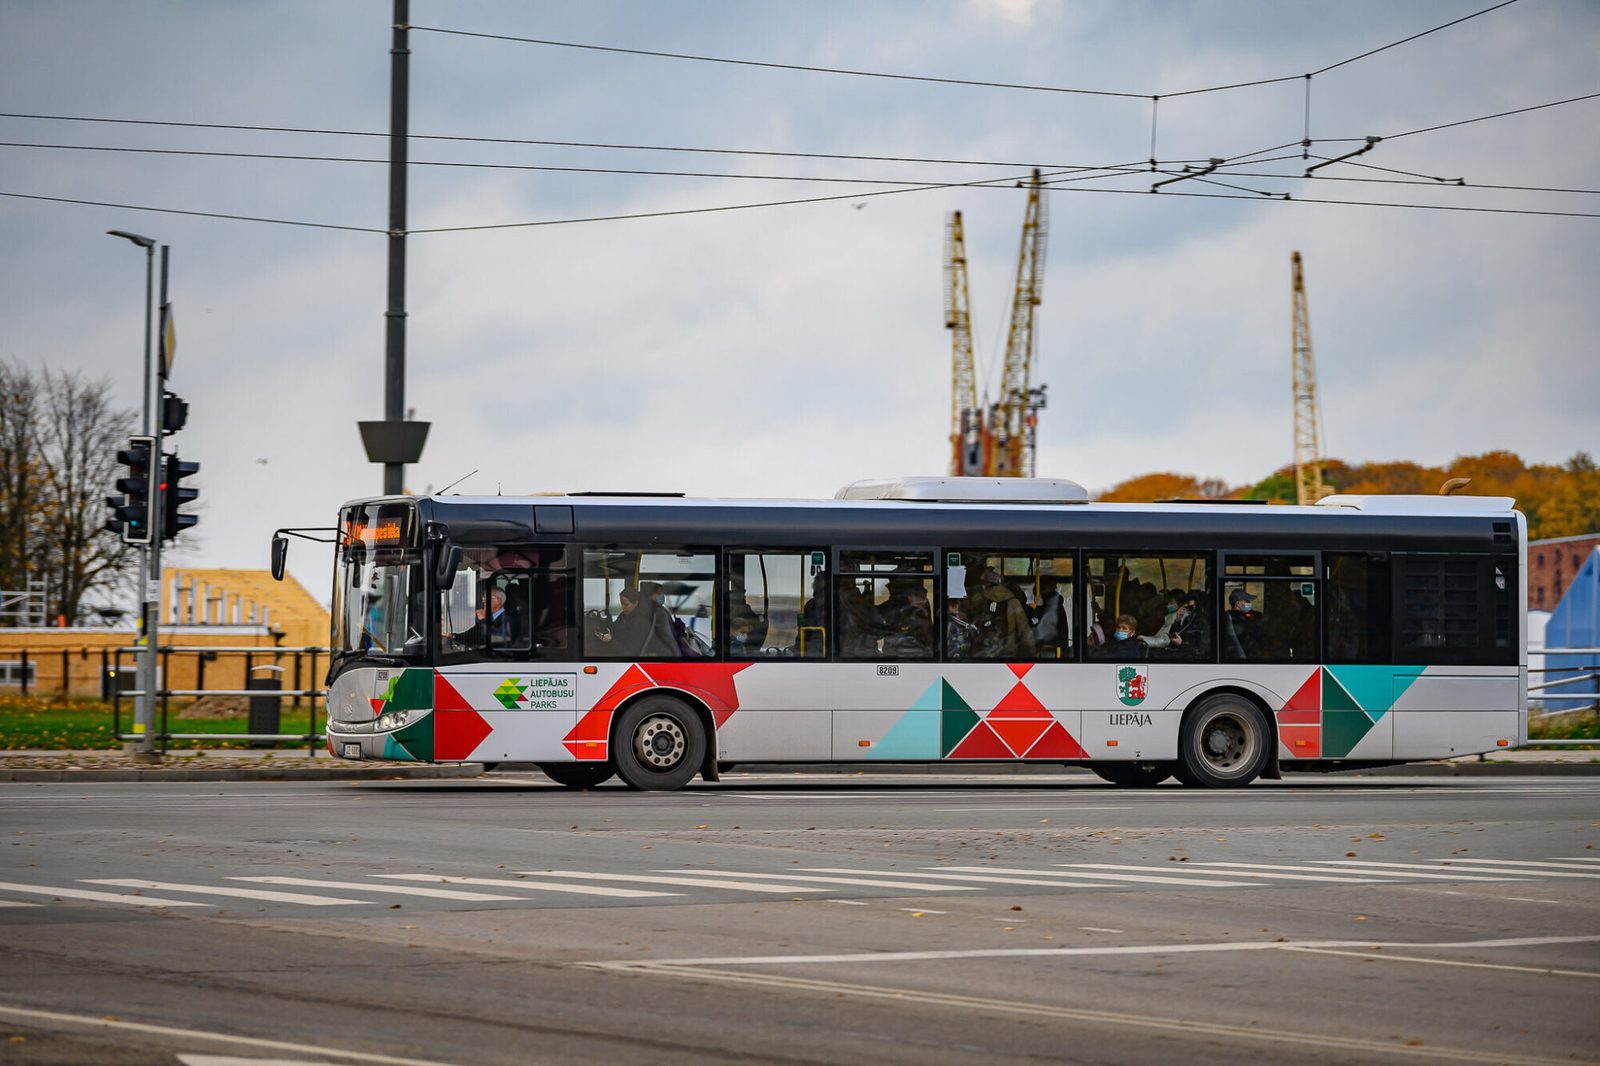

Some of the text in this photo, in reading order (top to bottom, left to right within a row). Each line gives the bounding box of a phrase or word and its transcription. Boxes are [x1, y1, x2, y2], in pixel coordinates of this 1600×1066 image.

[879, 666, 897, 675] 8209
[530, 678, 568, 687] LIEPĀJAS
[530, 690, 574, 698] AUTOBUSU
[530, 701, 557, 709] PARKS
[1109, 712, 1153, 727] LIEPĀJA
